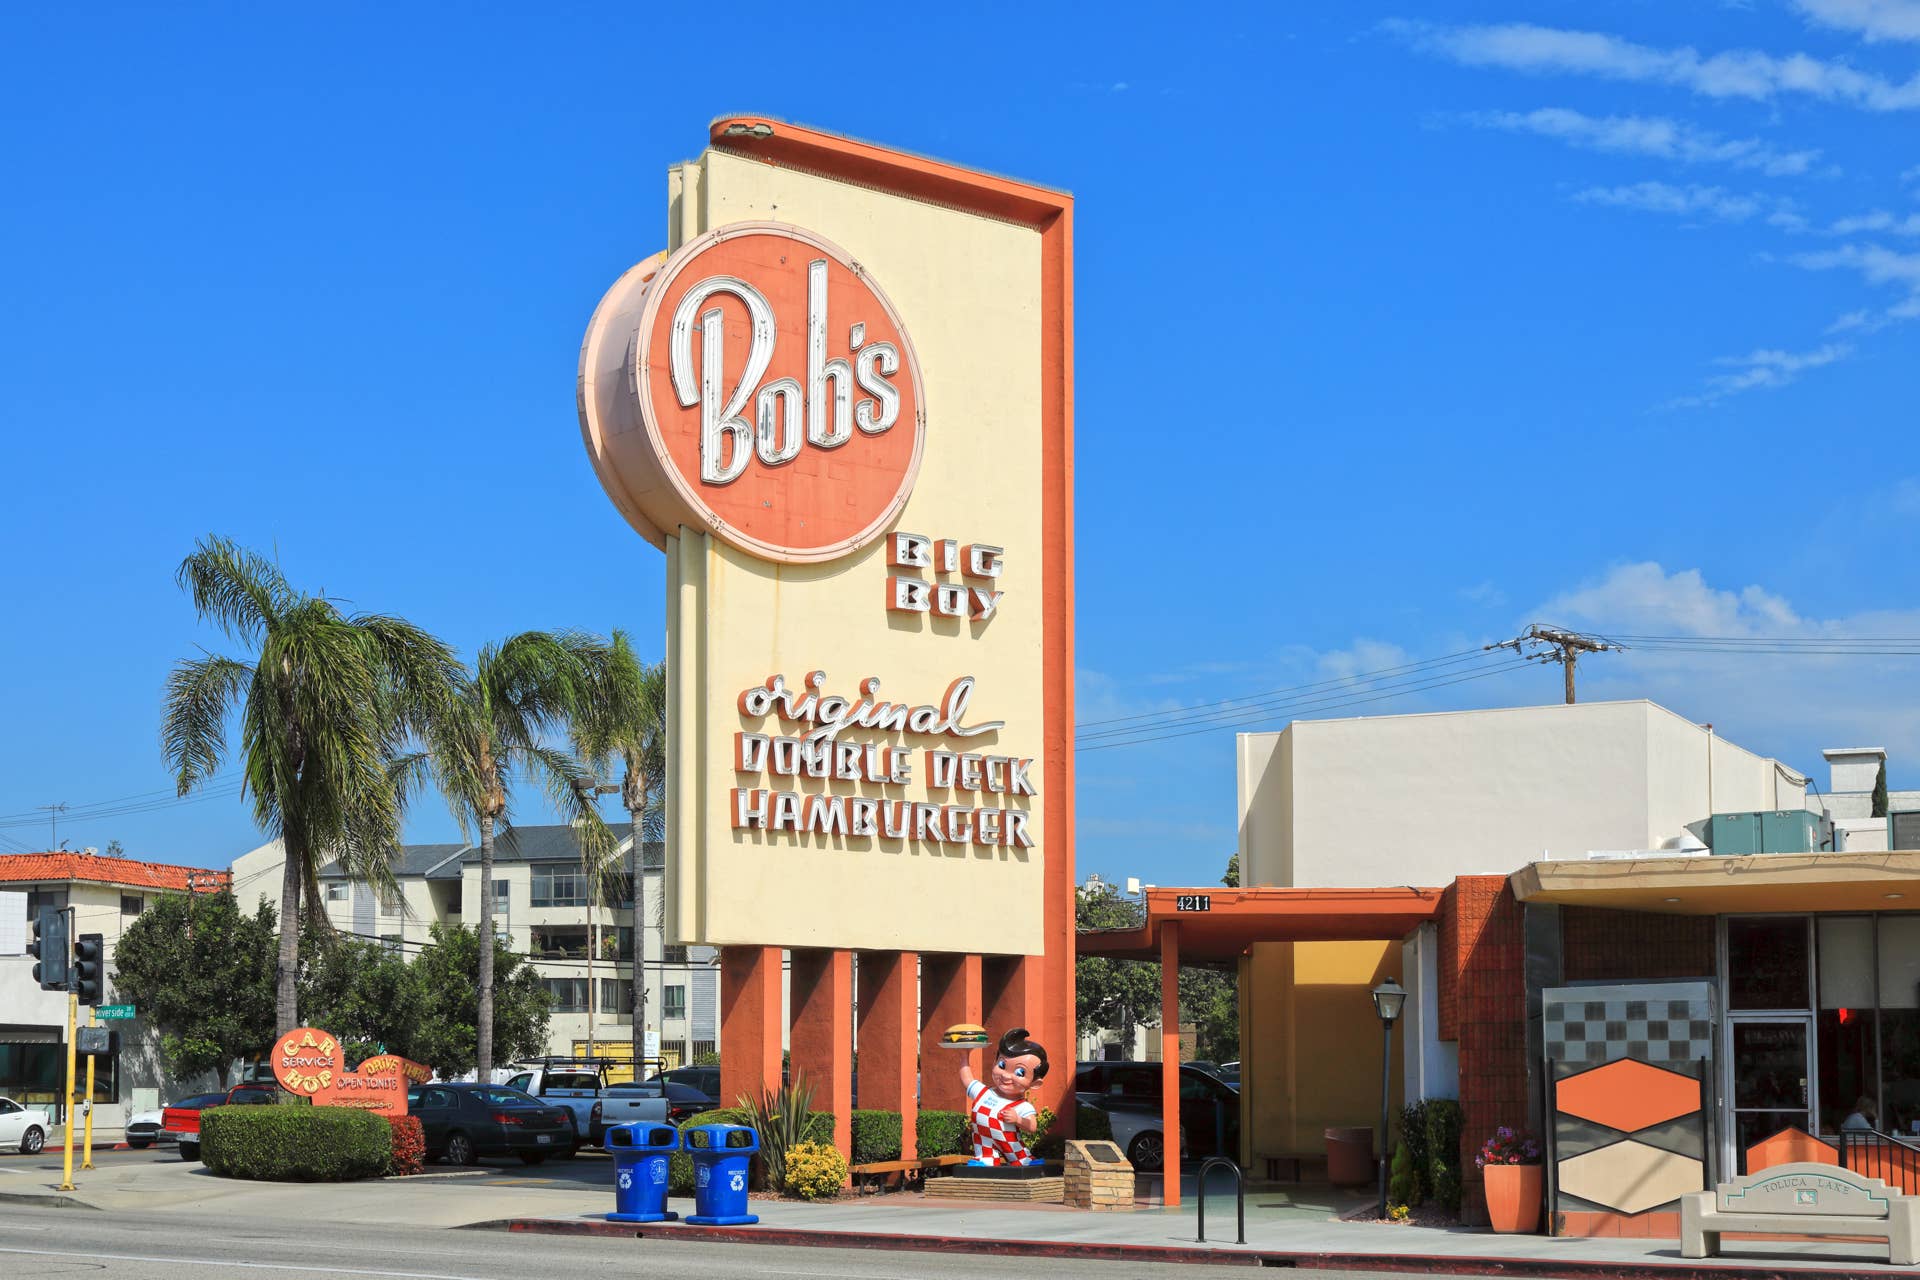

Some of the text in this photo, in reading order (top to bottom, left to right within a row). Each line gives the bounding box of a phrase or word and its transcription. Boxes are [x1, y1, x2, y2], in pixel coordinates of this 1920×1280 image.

[669, 258, 900, 485] Bob's
[886, 532, 1004, 579] BIG
[886, 576, 1004, 622] BOY
[737, 670, 1005, 762] original
[734, 732, 1037, 796] DOUBLE DECK
[730, 788, 1036, 848] HAMBURGER
[1177, 896, 1209, 911] 4211
[283, 1031, 335, 1057] CAR
[282, 1056, 335, 1067] SERVICE
[365, 1057, 430, 1082] DRIVE THRU
[283, 1068, 333, 1093] HOP
[336, 1077, 398, 1091] OPEN TONITE
[1763, 1178, 1850, 1195] TOLUCA LAKE
